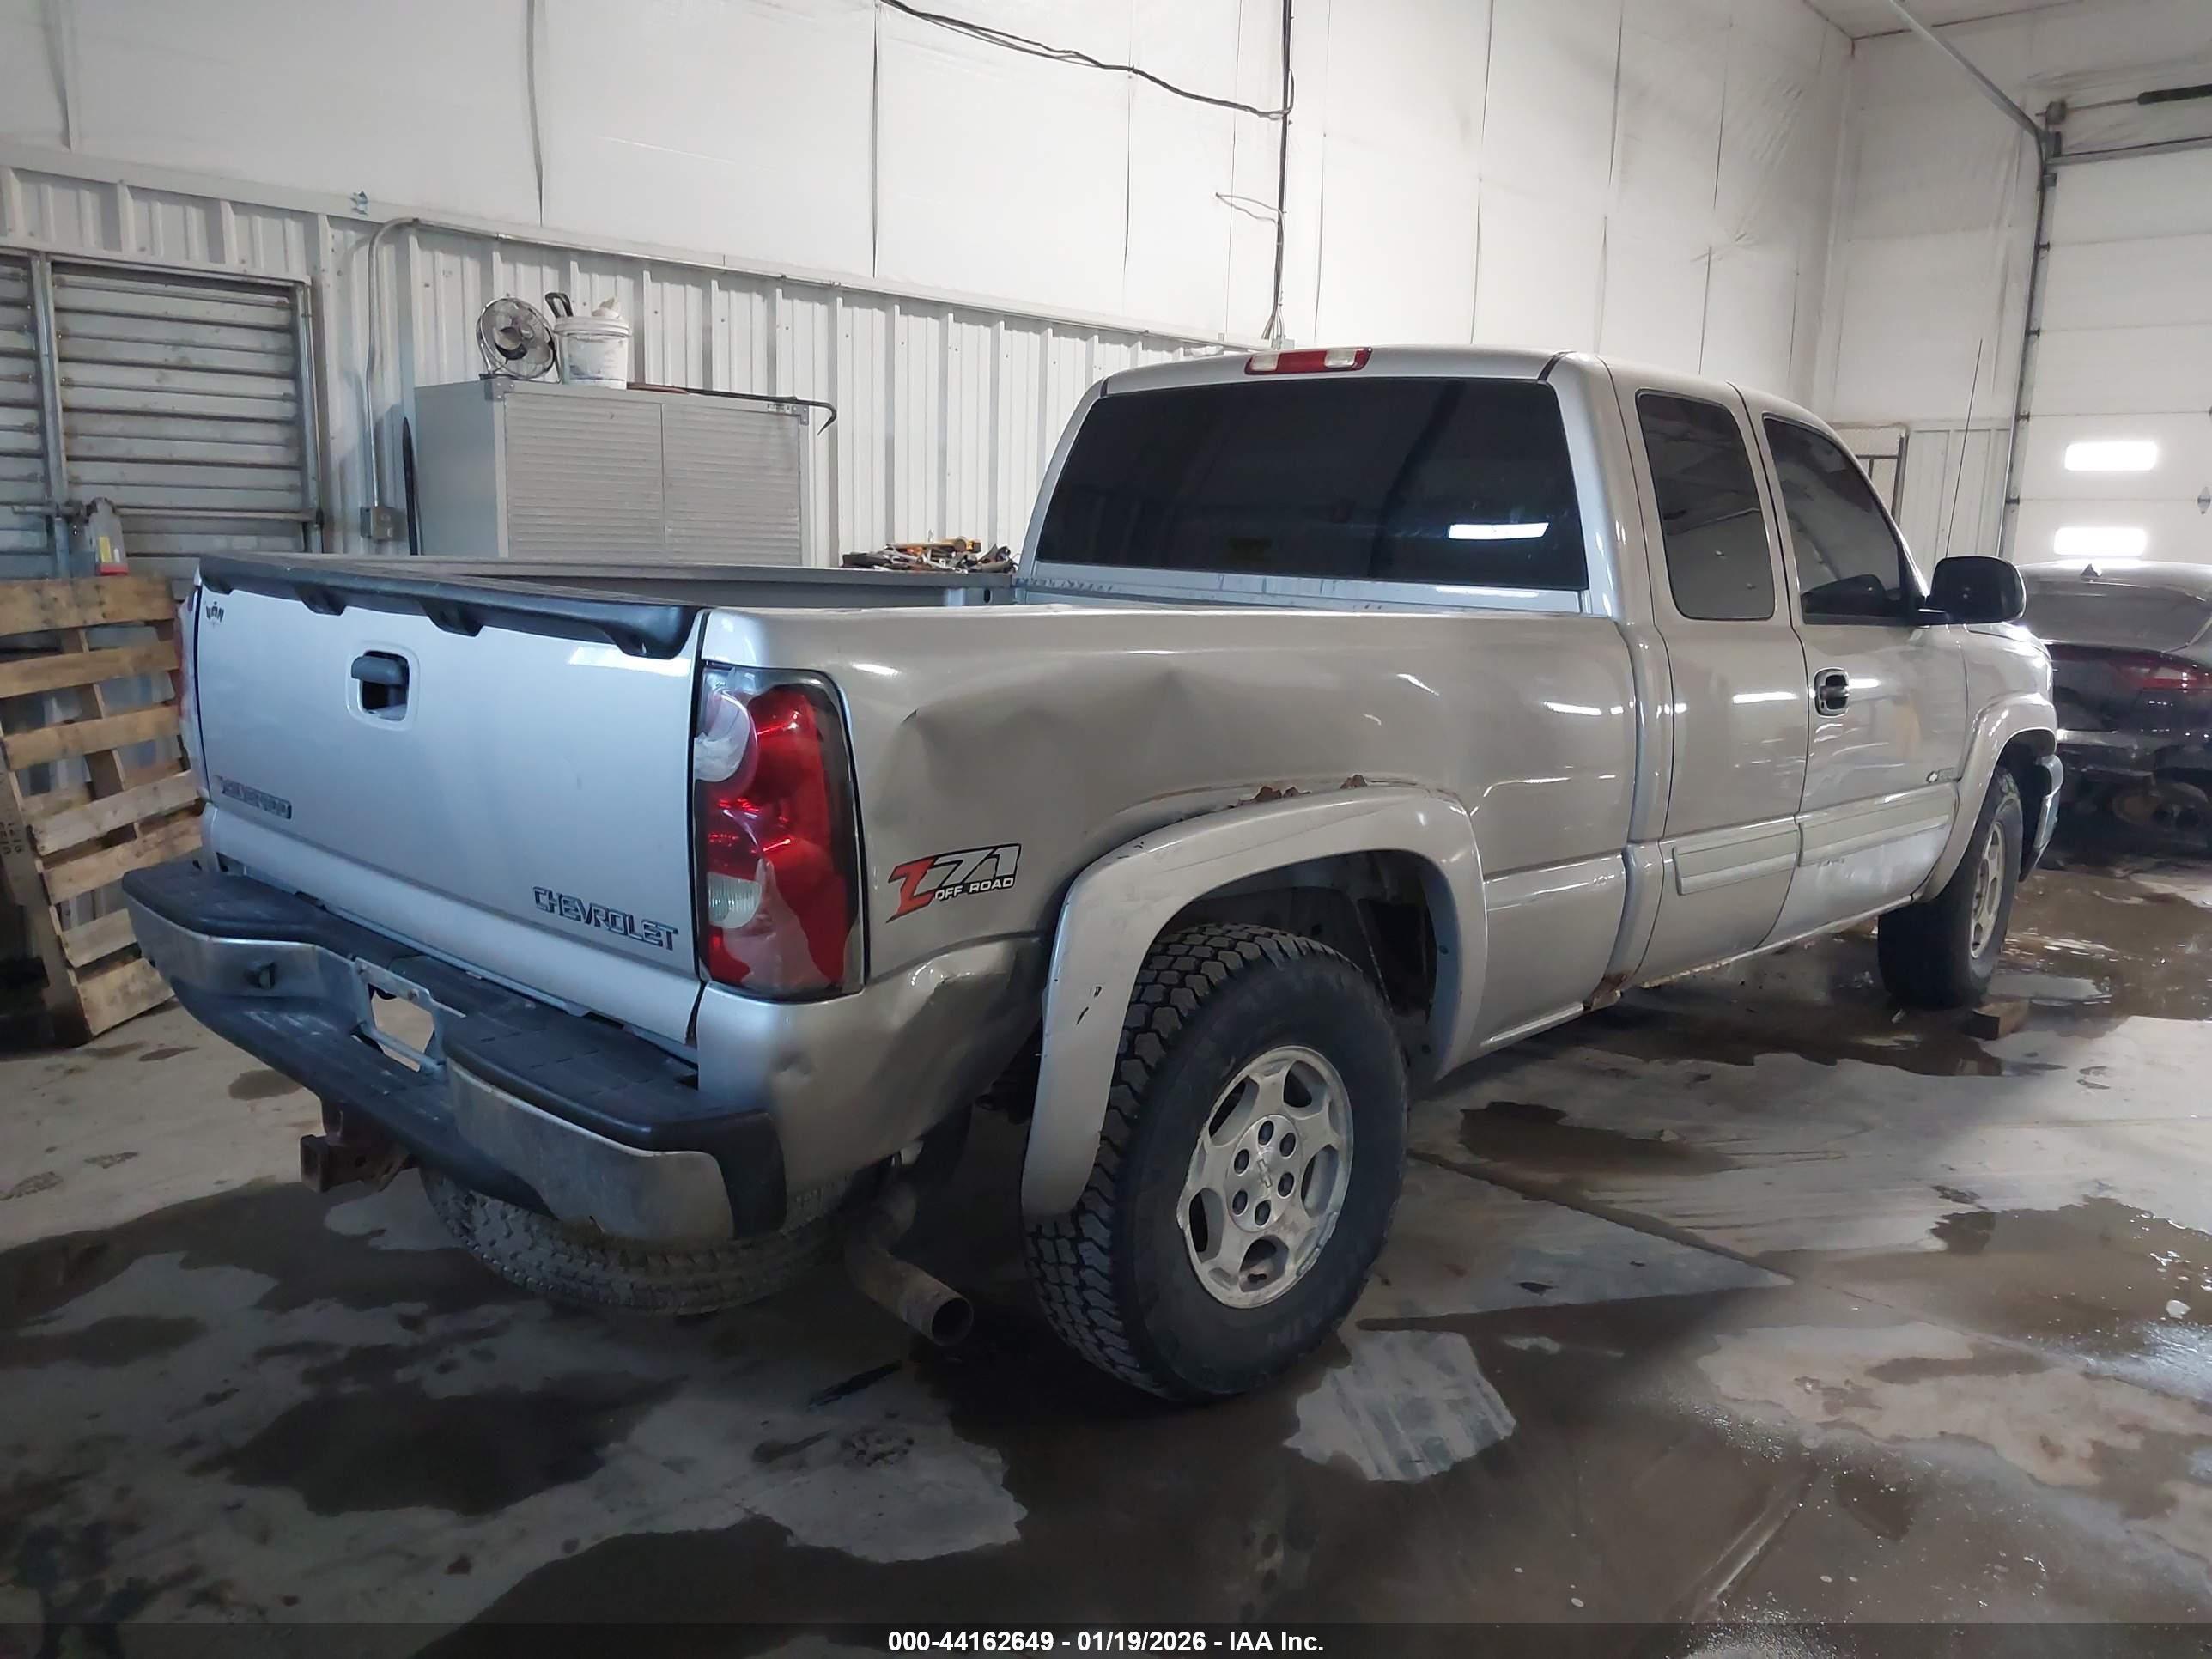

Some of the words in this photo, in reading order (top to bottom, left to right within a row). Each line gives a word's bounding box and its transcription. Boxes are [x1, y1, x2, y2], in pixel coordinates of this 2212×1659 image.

[886, 843, 1021, 923] Z71
[934, 885, 963, 901] OFF
[969, 877, 1015, 894] ROAD
[532, 885, 679, 951] CHEVROLET
